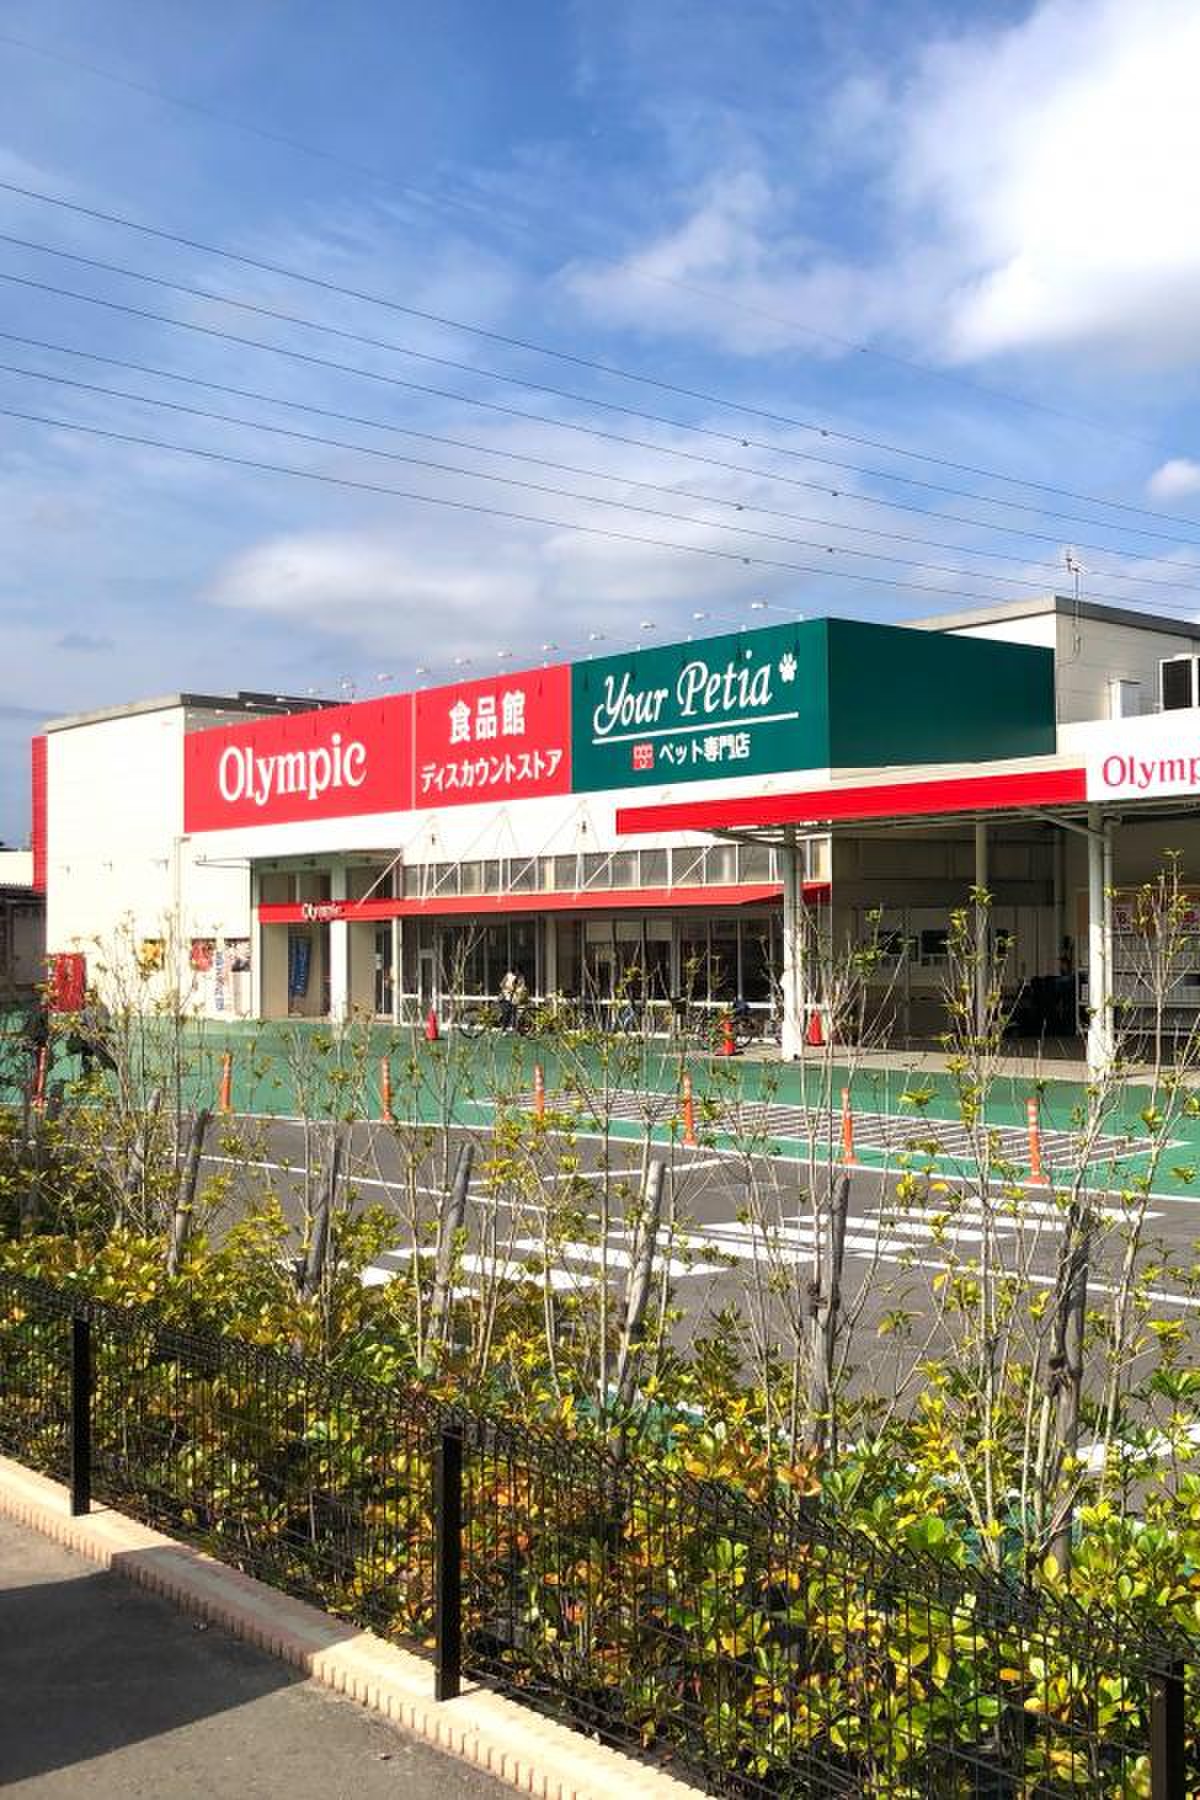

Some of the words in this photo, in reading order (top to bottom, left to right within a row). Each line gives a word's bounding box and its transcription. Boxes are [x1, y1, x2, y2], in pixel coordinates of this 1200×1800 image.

[448, 688, 527, 745] 食品館
[592, 671, 670, 736] Your
[676, 649, 773, 717] Petia
[218, 732, 367, 807] Olympic
[419, 748, 564, 794] ディスカウントストア
[658, 731, 751, 766] ペット専門店
